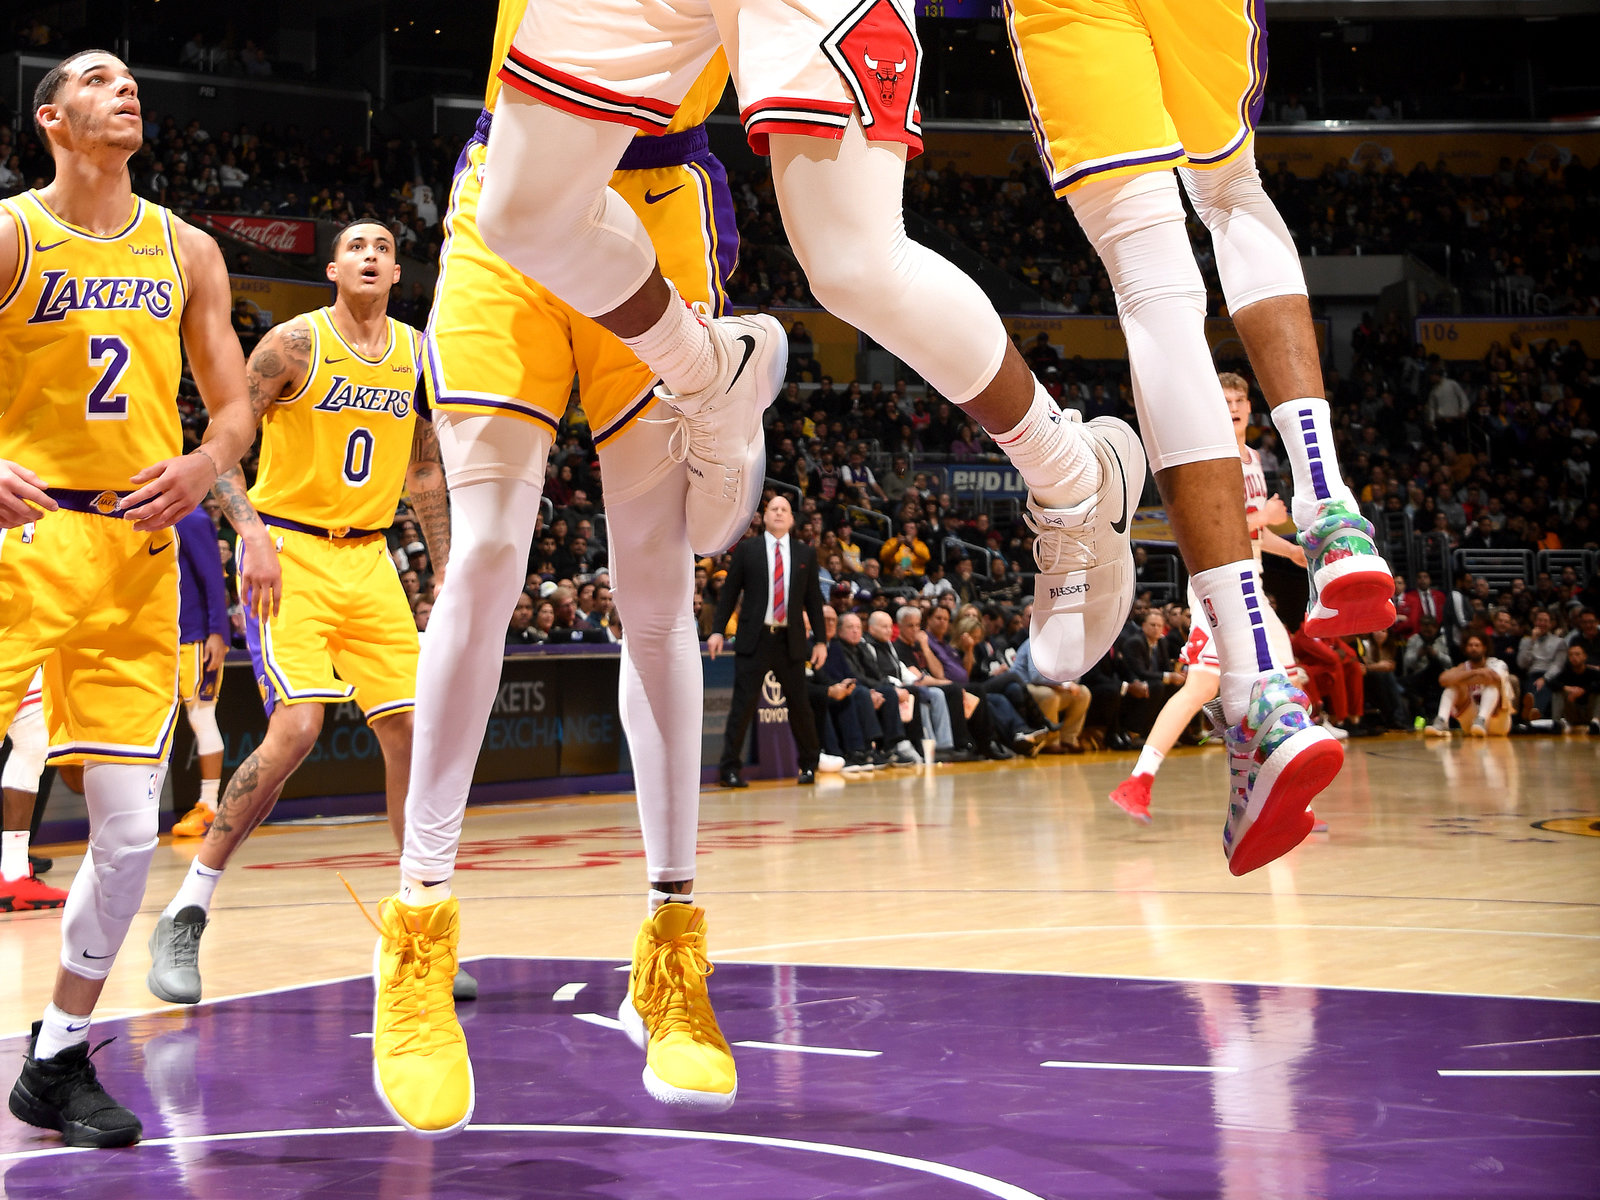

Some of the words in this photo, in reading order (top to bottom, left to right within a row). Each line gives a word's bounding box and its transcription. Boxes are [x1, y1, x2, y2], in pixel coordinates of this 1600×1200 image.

[924, 4, 944, 18] 131
[128, 244, 163, 256] wish
[27, 269, 173, 325] LAKERS
[1422, 323, 1458, 342] 106
[85, 335, 131, 420] 2
[391, 364, 412, 374] wish
[312, 375, 411, 420] LAKERS
[341, 426, 376, 488] 0
[953, 471, 1000, 491] BUD
[1050, 583, 1091, 599] BLESSED
[488, 714, 614, 750] EXCHANGE
